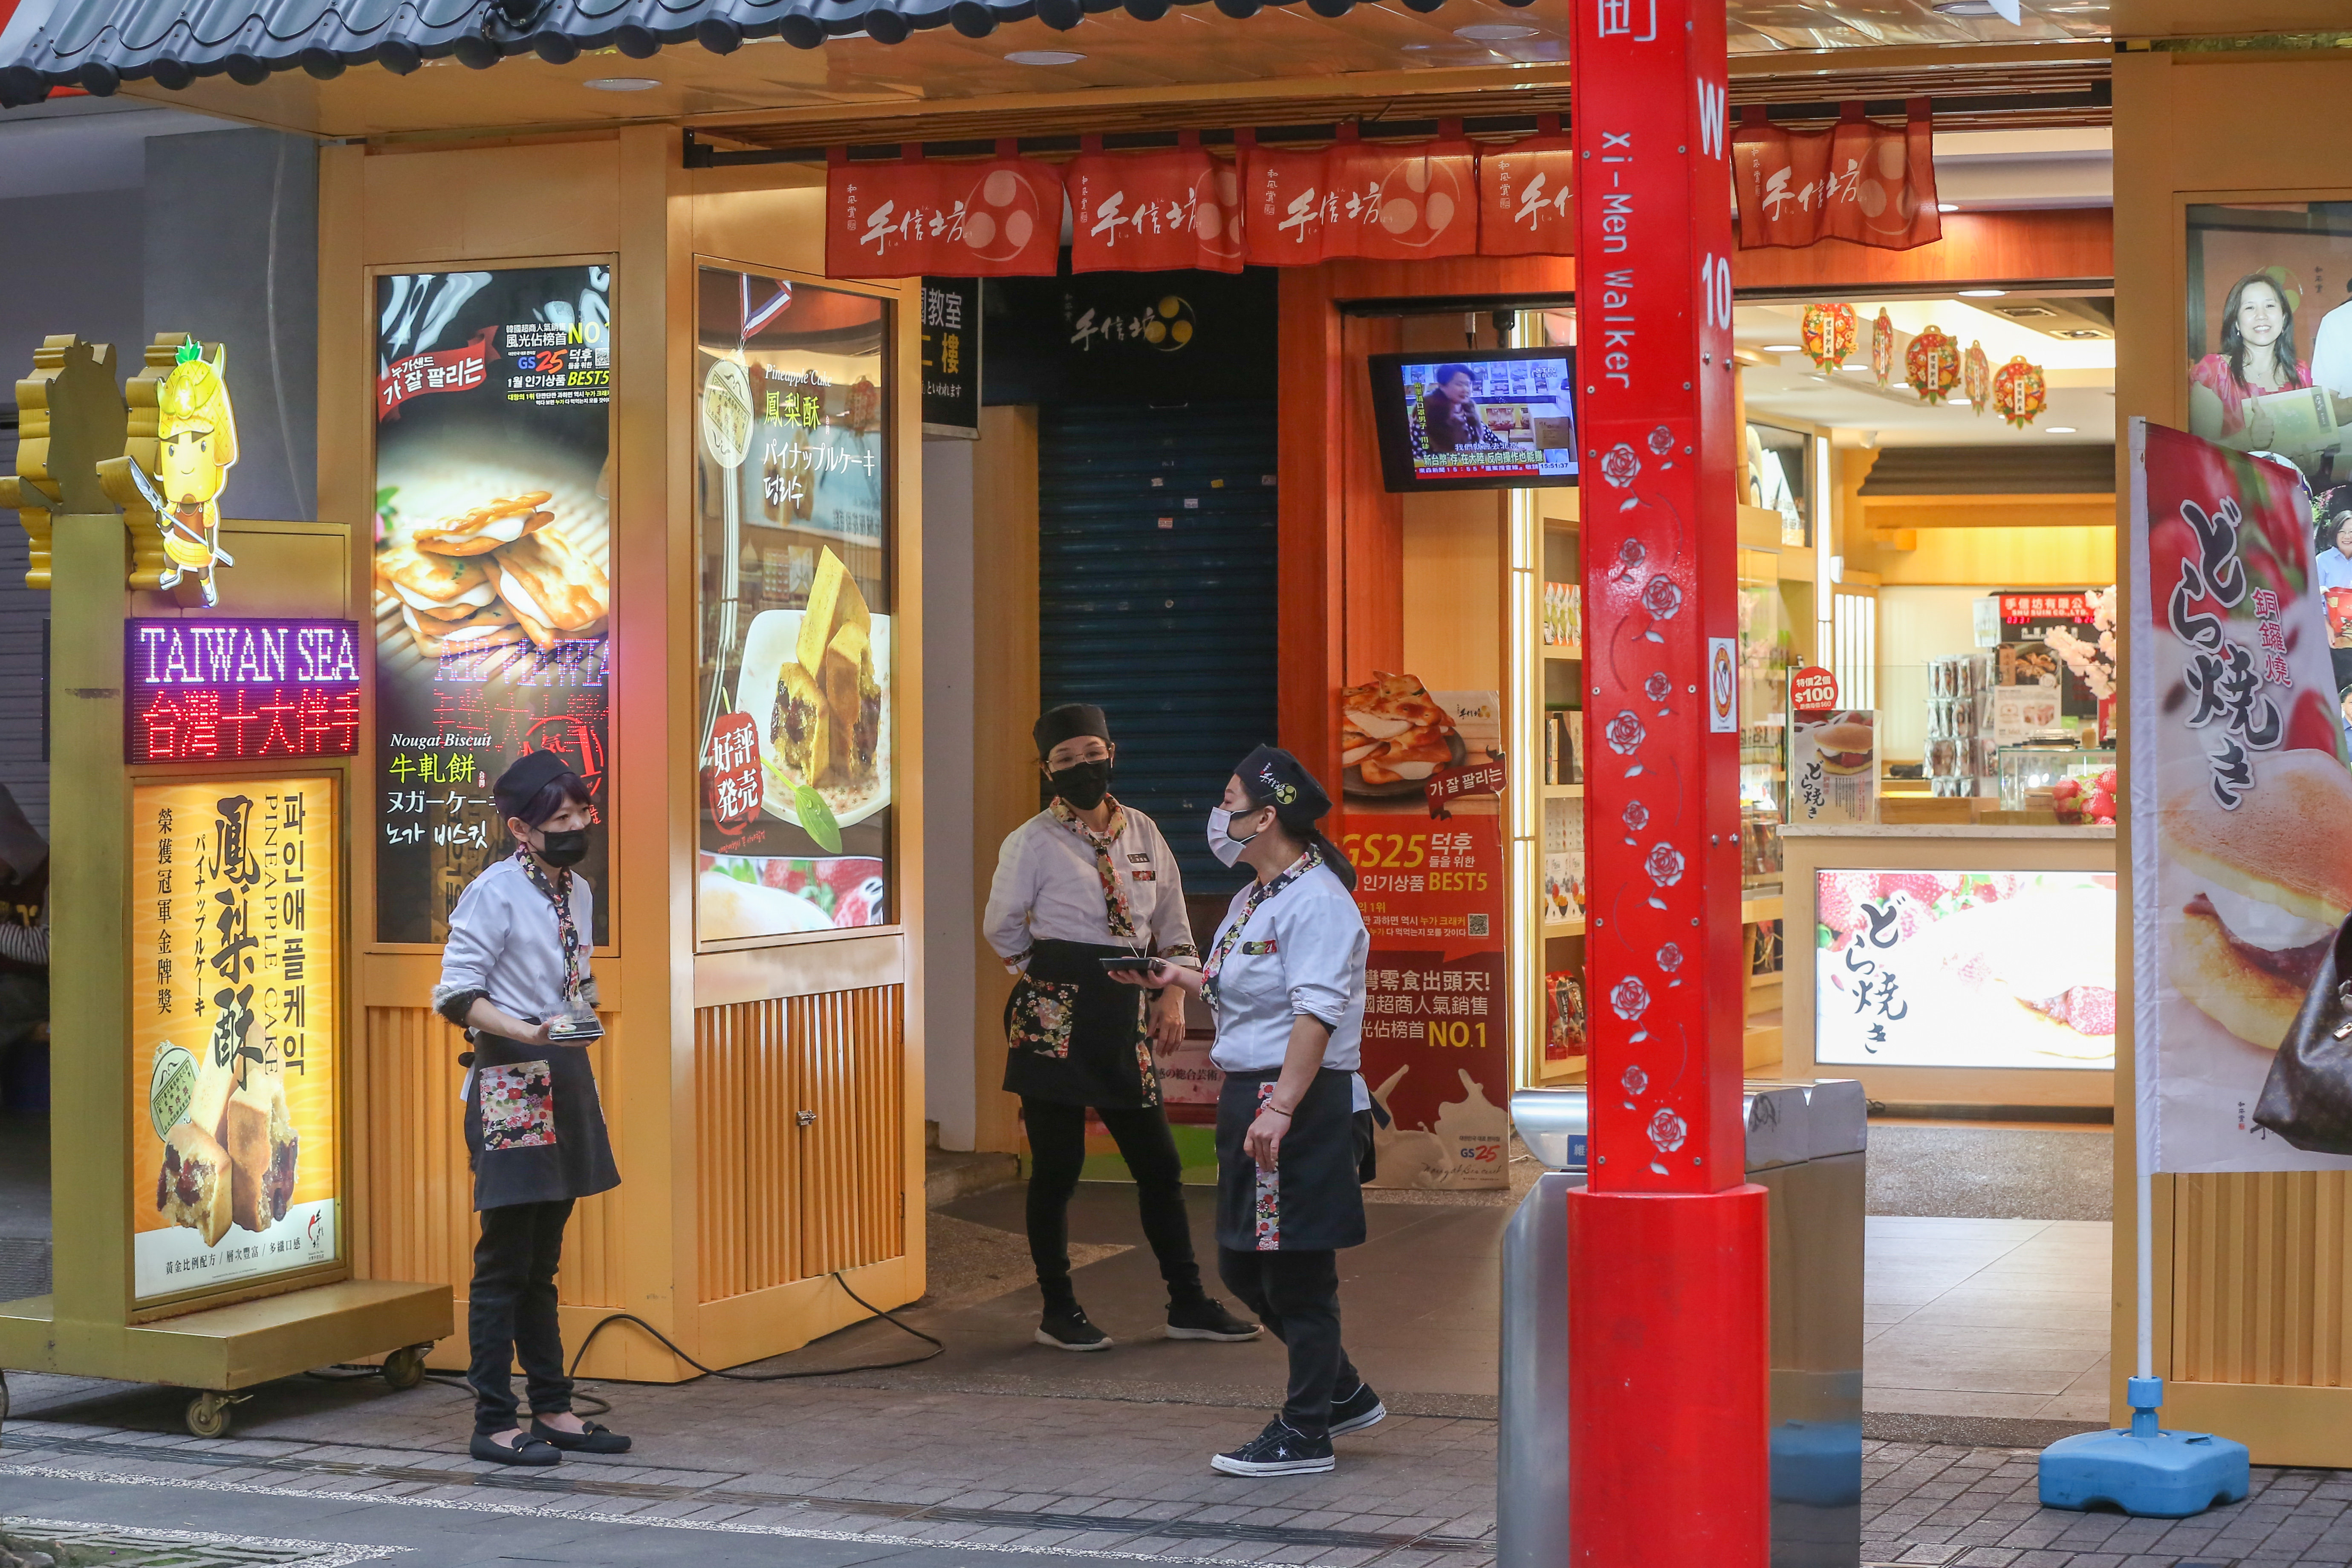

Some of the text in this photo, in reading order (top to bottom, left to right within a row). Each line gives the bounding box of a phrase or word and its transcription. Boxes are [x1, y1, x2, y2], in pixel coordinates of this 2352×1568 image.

[1697, 78, 1730, 330] W 10
[1762, 159, 1860, 221] 手信坊
[860, 199, 966, 255] 手信坊
[1091, 188, 1196, 247] 手信坊
[1278, 181, 1381, 243] 手信坊
[1602, 131, 1635, 388] Xi-Men Walker
[506, 332, 567, 347] 風光佔榜首
[1071, 306, 1156, 351] 手信坊
[391, 355, 435, 379] 누가샌드
[518, 349, 568, 374] GS25
[569, 348, 593, 362] 덕후
[383, 357, 484, 405] 가 잘 팔리는
[507, 370, 610, 388] 1월 인기상품 BEST5
[765, 363, 832, 387] Pineapple Cake
[507, 393, 525, 401] 대망의
[763, 390, 821, 430] 鳳梨酥
[763, 438, 875, 476] パイナップルケーキ
[2170, 497, 2281, 810] どら焼き
[2251, 588, 2292, 687] 銅鑼燒
[140, 627, 360, 683] TAIWAN SEA
[1795, 686, 1835, 703] $100
[1796, 675, 1831, 687] 特價2個
[390, 733, 493, 750] Nougat Biscuit
[388, 752, 477, 784] 牛軋餅
[1430, 767, 1503, 797] 가 잘 팔리는
[1801, 760, 1825, 819] どら焼き
[1342, 833, 1427, 868] GS25
[1431, 832, 1473, 856] 덕후
[1429, 855, 1476, 868] 들을 위한
[1363, 875, 1425, 892] 인기상품
[1429, 872, 1488, 892] BEST5
[158, 808, 173, 1016] 榮獲冠軍金牌獎
[1370, 902, 1386, 913] 1위
[1373, 916, 1399, 926] 과하면
[1401, 916, 1418, 926] 역시
[1420, 916, 1438, 926] 누가
[1439, 916, 1466, 926] 크래커
[194, 834, 206, 1017] パイナップルケーキ
[264, 793, 278, 1075] PINEAPPLE CAKE
[1370, 927, 1385, 936] 누가
[1386, 927, 1394, 936] 다
[208, 795, 264, 1091] 鳳梨酥
[1845, 895, 1908, 1054] どら焼き
[1428, 1020, 1487, 1048] NO.1
[1460, 1145, 1501, 1163] GS25
[165, 1253, 216, 1275] 黃金比例配方
[226, 1245, 259, 1263] 層次豐富
